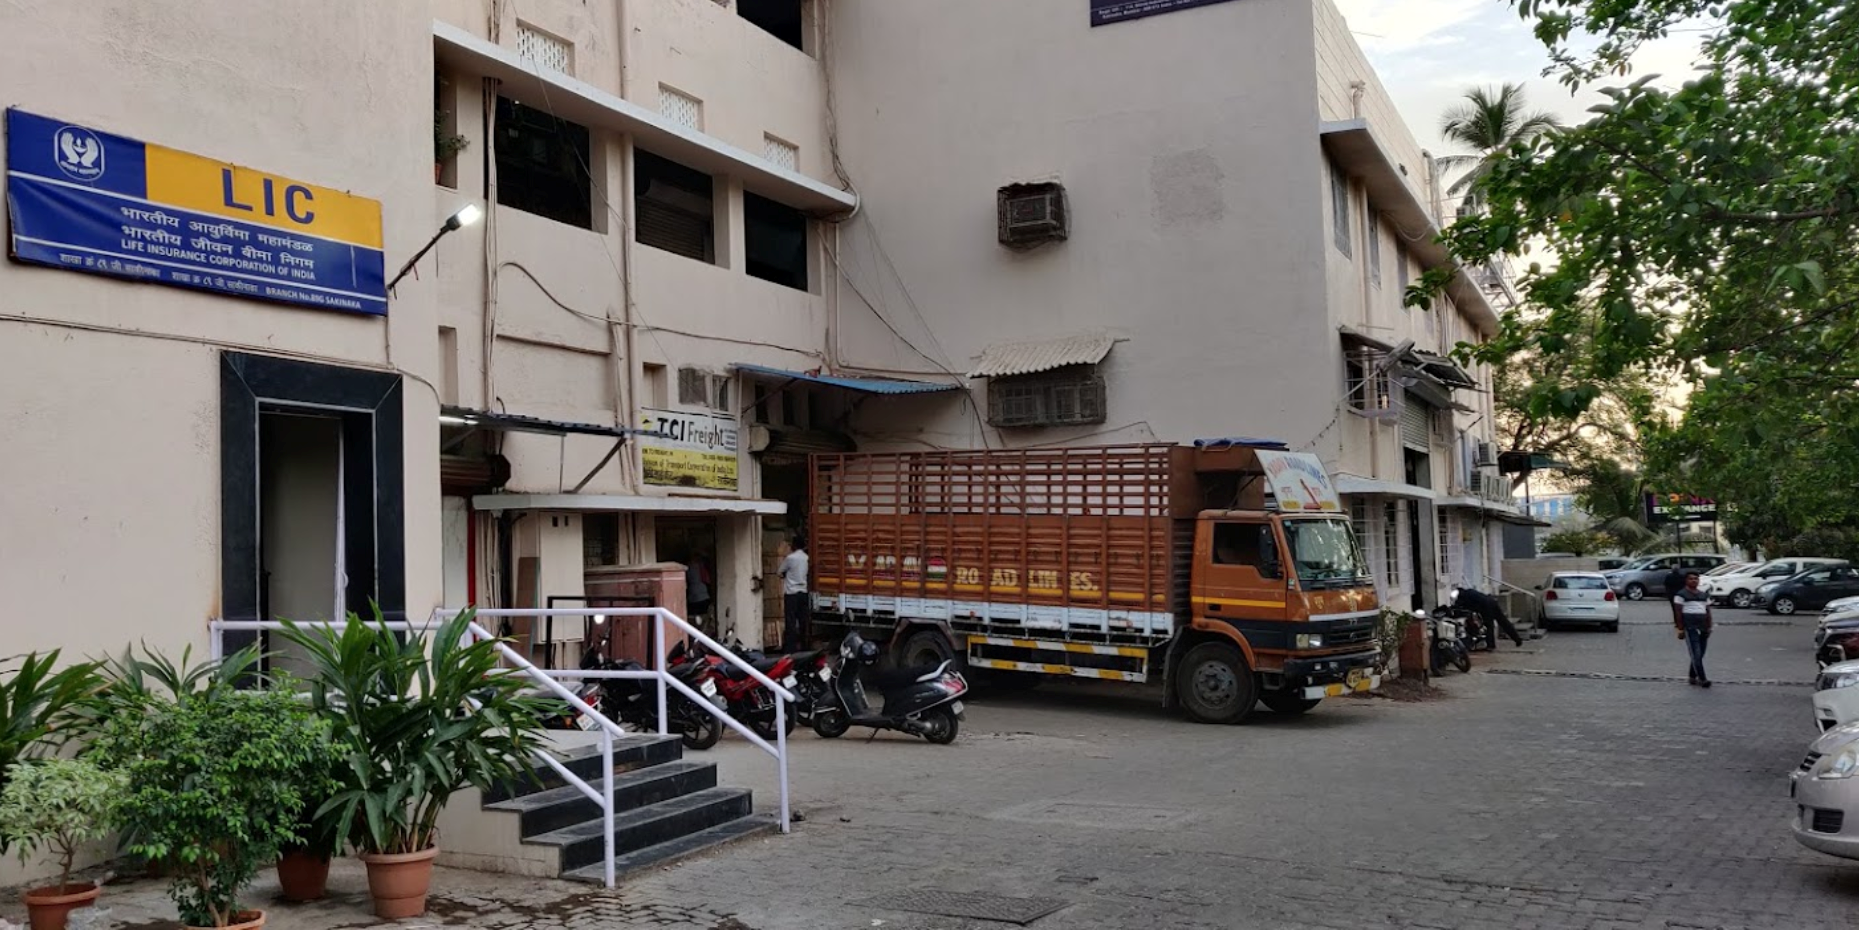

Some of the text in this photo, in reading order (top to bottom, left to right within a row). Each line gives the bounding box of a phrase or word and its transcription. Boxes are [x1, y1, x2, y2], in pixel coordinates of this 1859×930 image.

[222, 168, 315, 225] LIC
[121, 206, 180, 228] भारतीय
[257, 233, 314, 252] महामंडळ
[121, 225, 315, 269] भारतीय जीवन बीमा निगम
[121, 238, 316, 281] LIFE INSURANCE CORPORATION OF INDIA
[265, 286, 298, 300] BRANCH
[657, 417, 686, 440] TCI
[687, 421, 724, 450] Freight
